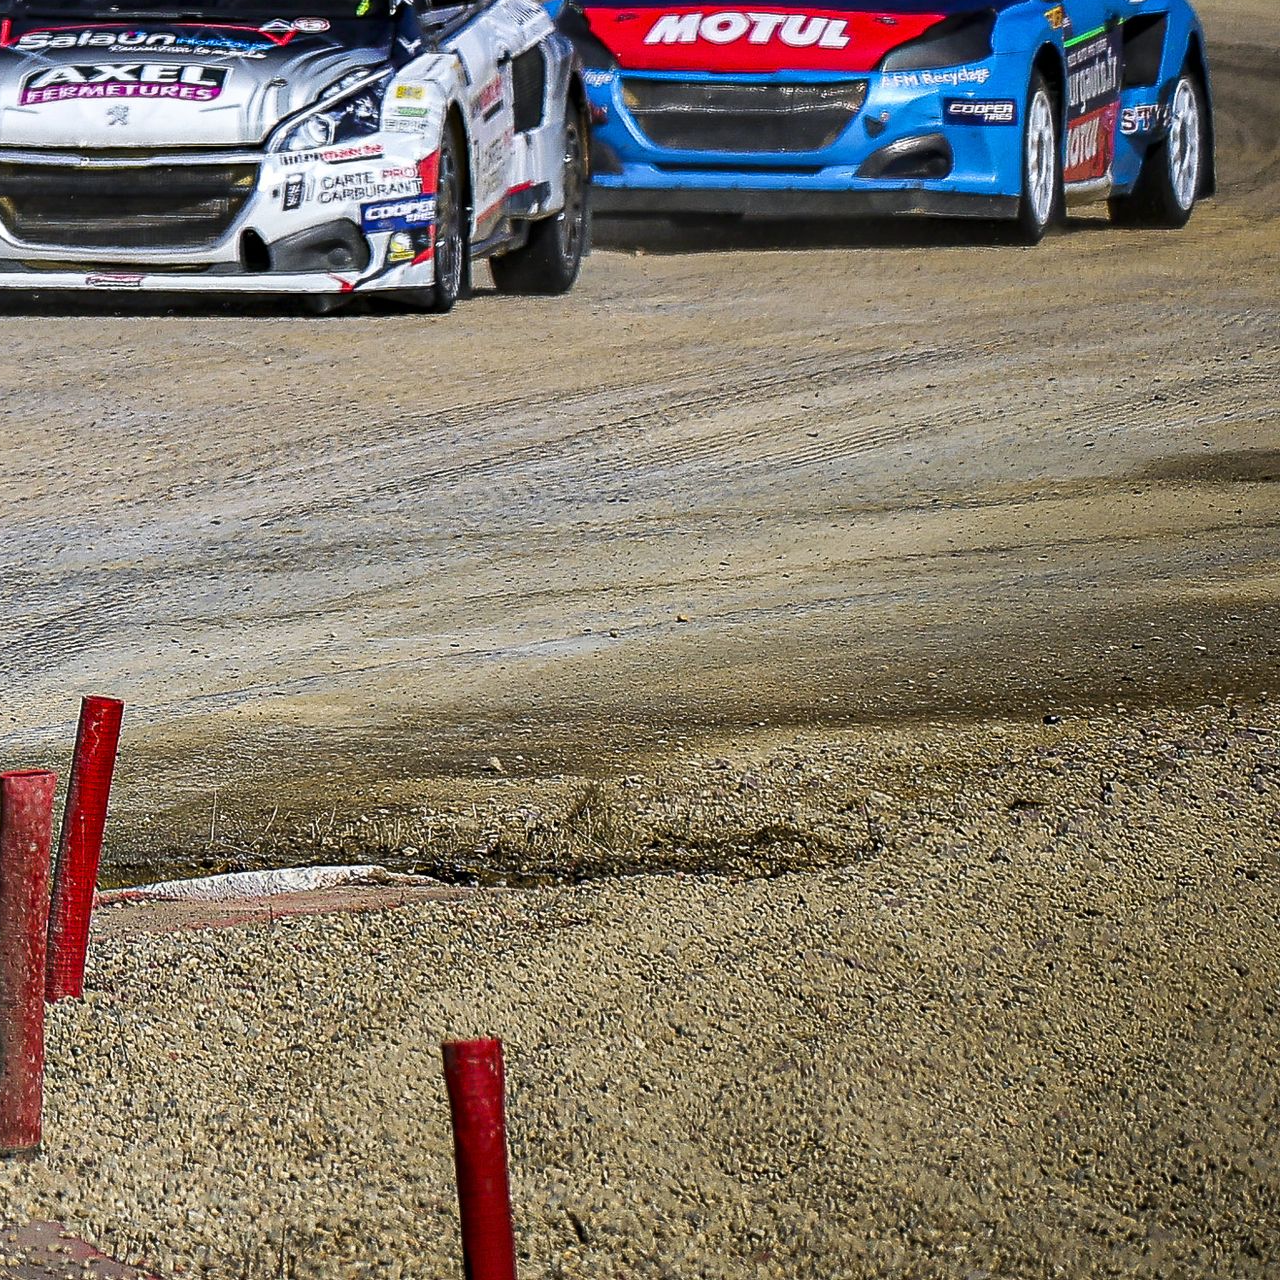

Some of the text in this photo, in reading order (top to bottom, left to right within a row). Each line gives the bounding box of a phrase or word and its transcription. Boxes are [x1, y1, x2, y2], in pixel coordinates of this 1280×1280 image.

[643, 11, 851, 49] MOTUL
[30, 66, 219, 86] AXEL
[26, 84, 216, 104] FERMETURES
[949, 103, 1013, 114] COOPER
[984, 113, 1013, 121] TIRES
[321, 167, 417, 190] CARTE PRO
[318, 179, 422, 204] CARBURANT
